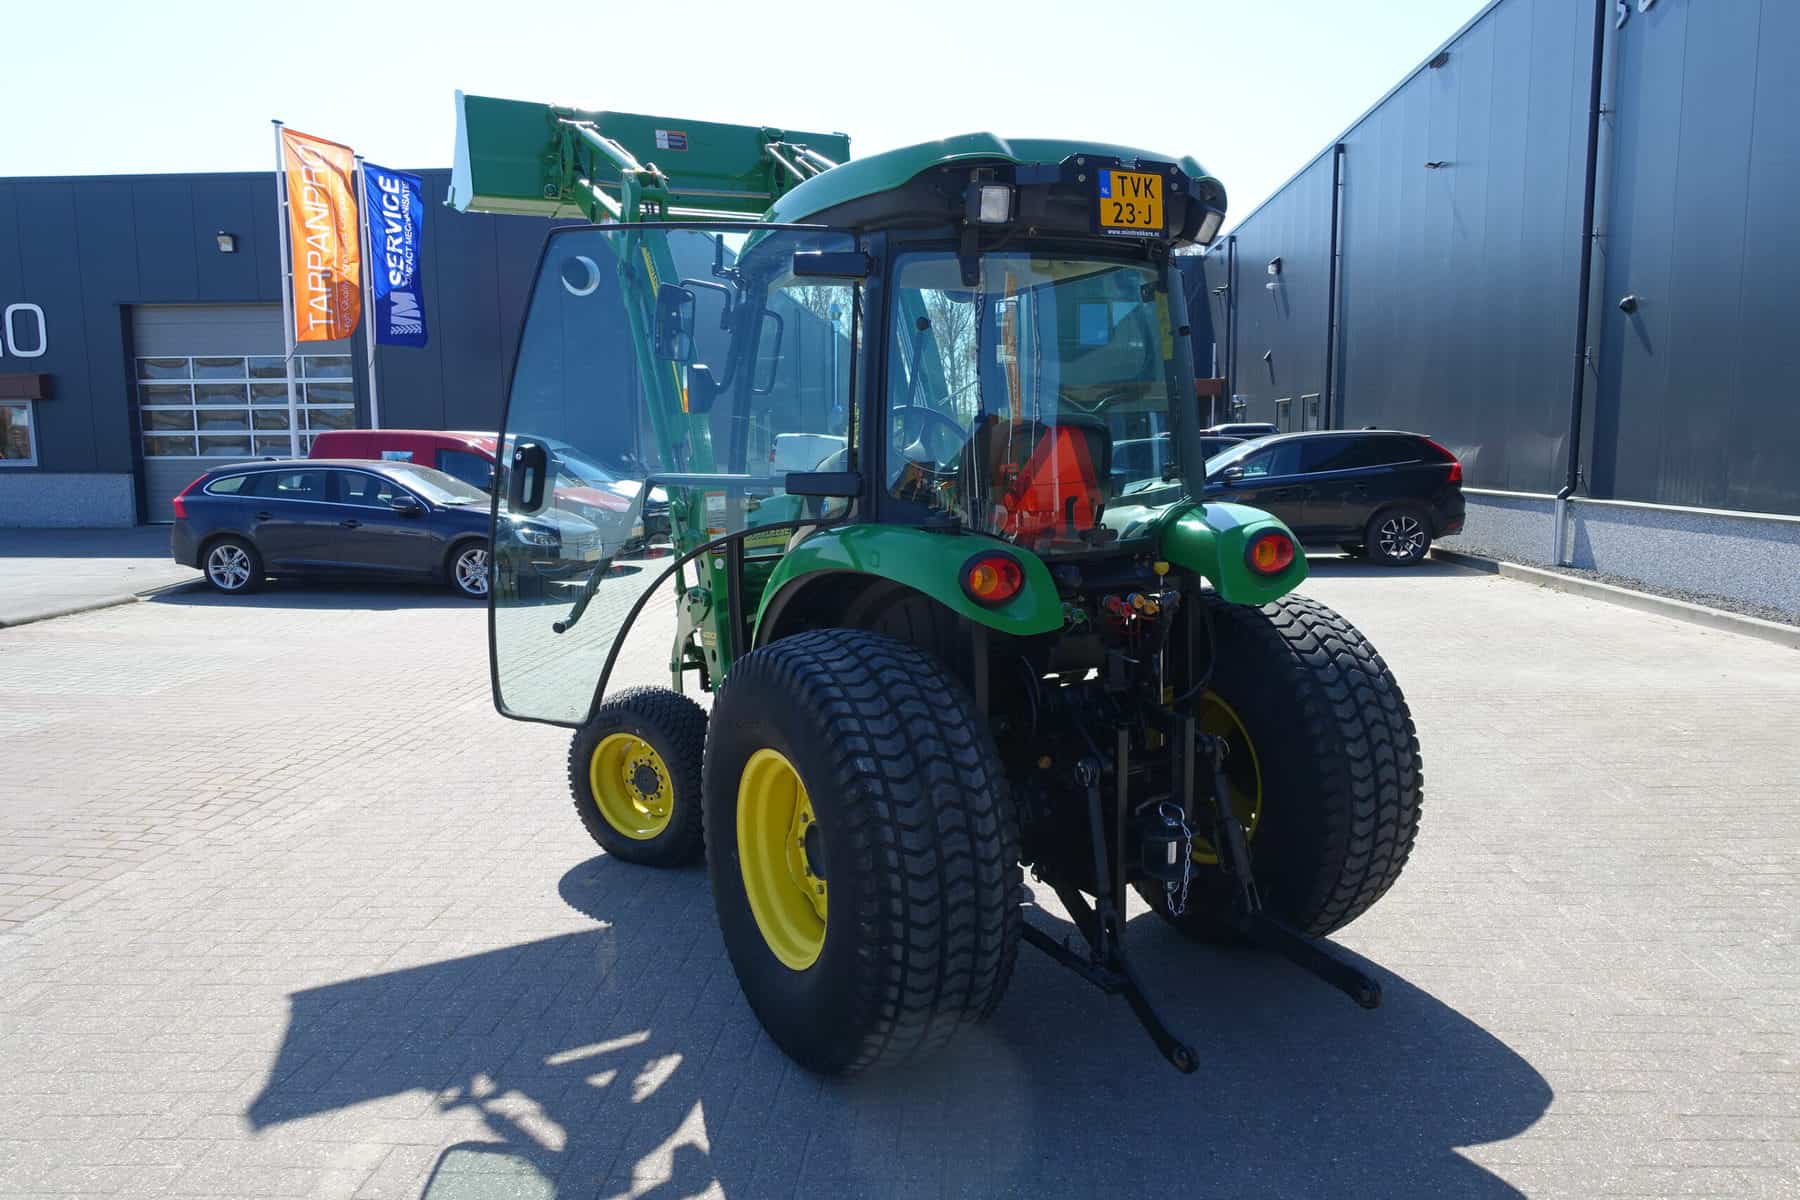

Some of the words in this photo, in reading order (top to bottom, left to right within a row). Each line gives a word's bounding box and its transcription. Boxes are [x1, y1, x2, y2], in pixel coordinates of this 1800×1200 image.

[1112, 202, 1152, 224] 23-J
[1117, 175, 1154, 199] TVK
[298, 144, 335, 331] TARPANPRO
[379, 175, 406, 286] SERVICE
